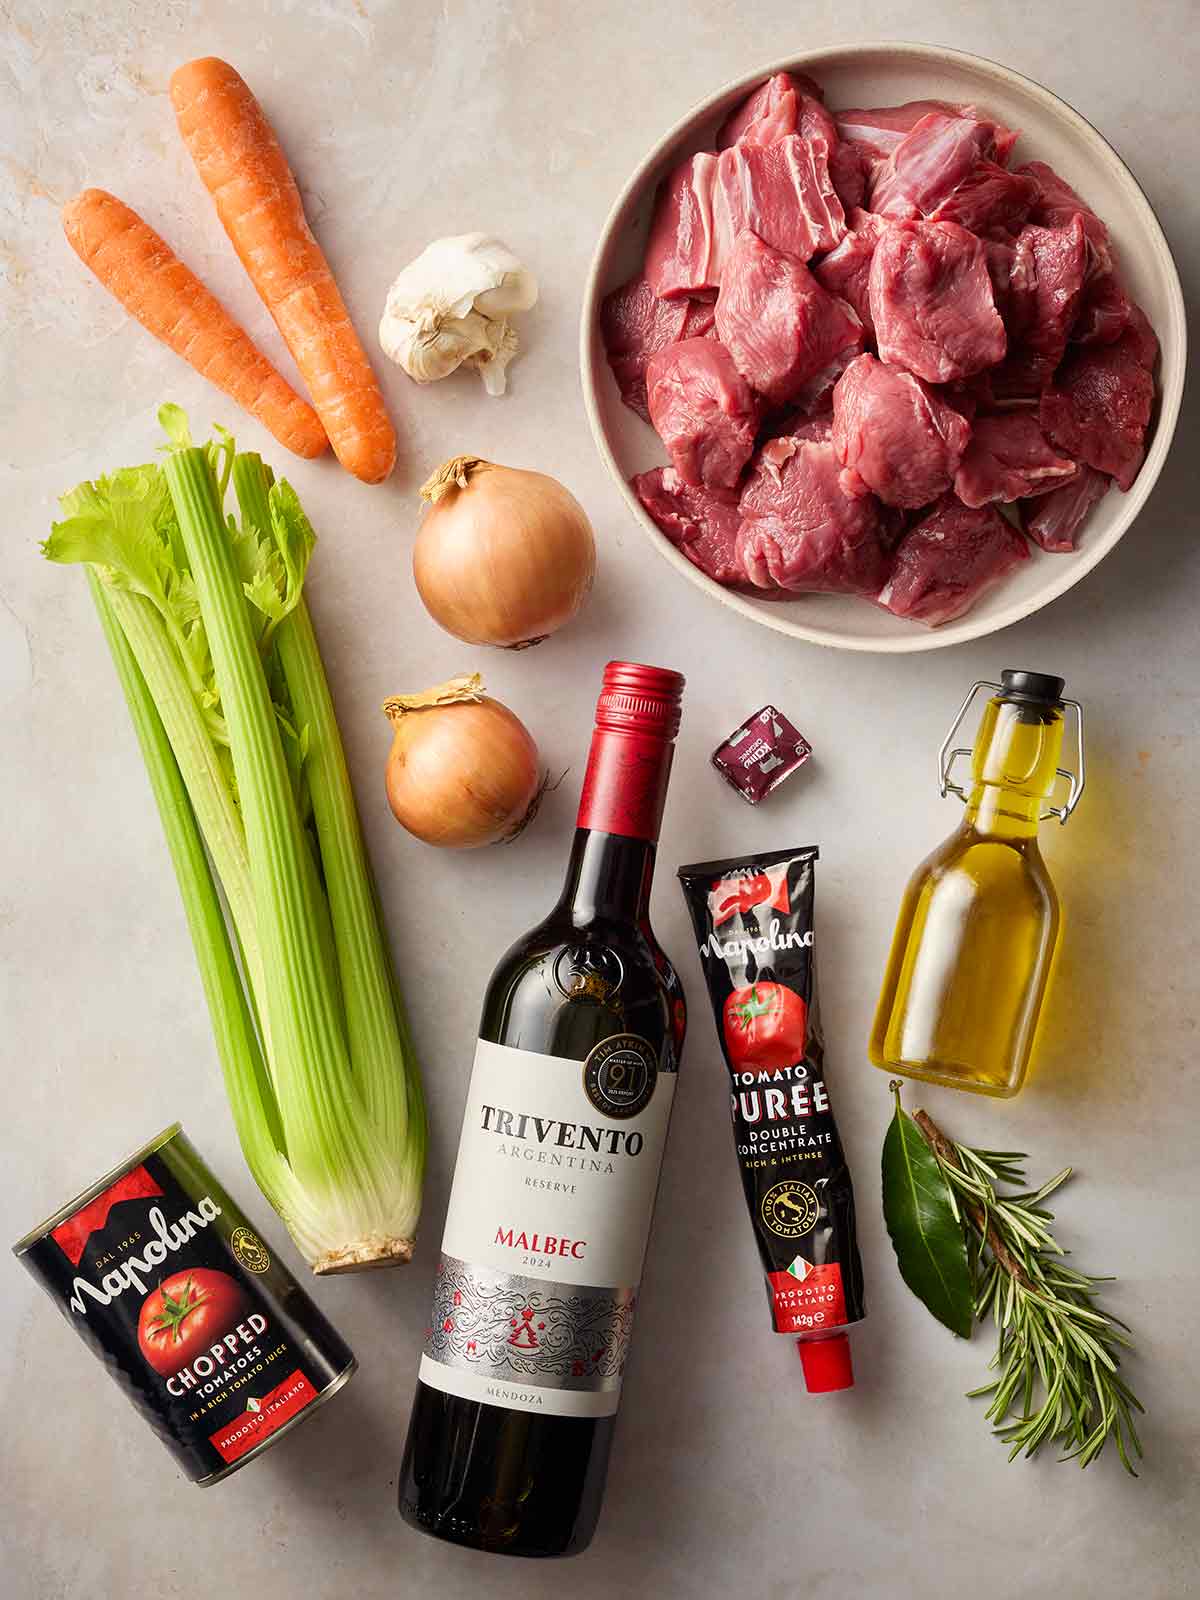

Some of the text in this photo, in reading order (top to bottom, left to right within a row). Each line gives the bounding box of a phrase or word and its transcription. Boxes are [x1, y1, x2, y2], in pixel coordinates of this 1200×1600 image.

[738, 738, 763, 762] ORGANIC
[700, 918, 815, 967] Napolina
[594, 1044, 613, 1062] TIM
[733, 1065, 807, 1087] TOMATO
[480, 1104, 644, 1157] TRIVENTO
[749, 1125, 807, 1142] DOUBLE
[738, 1133, 832, 1155] CONCENTRATE
[497, 1143, 616, 1174] ARGENTINA
[771, 1158, 777, 1166] &
[781, 1151, 823, 1164] INTENSE
[524, 1177, 577, 1194] RESERVE
[764, 1183, 816, 1217] 100% ITALIAN
[770, 1210, 817, 1235] TOMATOES
[70, 1196, 222, 1314] Napolina
[95, 1231, 142, 1270] DAL 1965
[494, 1225, 588, 1260] MALBEC
[522, 1255, 551, 1269] 2024
[775, 1284, 836, 1300] PRODOTTO
[779, 1294, 834, 1308] ITALIANO
[166, 1313, 268, 1397] CHOPPED
[190, 1412, 200, 1422] IN
[207, 1391, 228, 1409] RICH
[229, 1363, 264, 1393] TOMATO
[265, 1343, 288, 1365] JUICE
[195, 1345, 262, 1399] TOMATOES
[487, 1387, 543, 1405] MENDOZA
[221, 1381, 305, 1449] PRODOTTO ITALIANO
